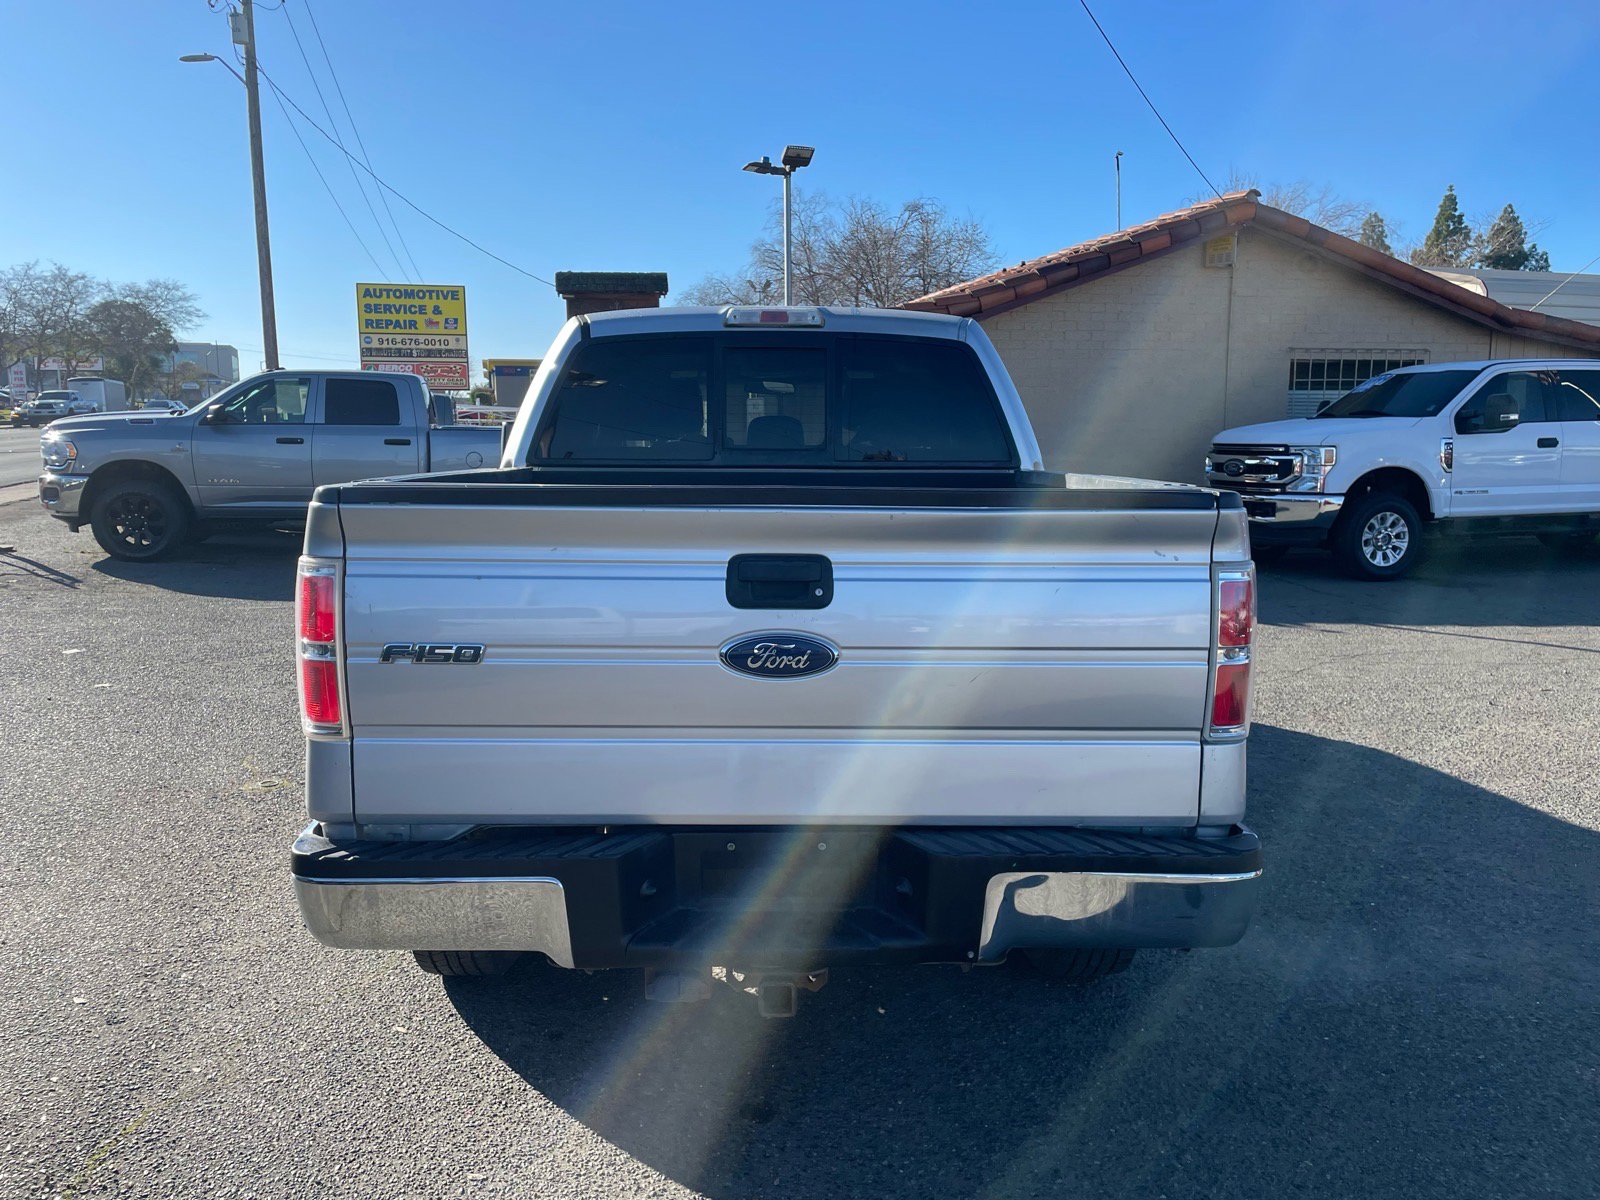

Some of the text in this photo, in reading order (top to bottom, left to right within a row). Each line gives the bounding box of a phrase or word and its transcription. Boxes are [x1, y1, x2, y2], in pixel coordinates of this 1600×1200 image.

[362, 287, 460, 300] AUTOMOTIVE
[363, 303, 443, 315] SERVICE &
[364, 318, 419, 330] REPAIR
[377, 337, 450, 347] 916-676-0010
[747, 642, 812, 669] Ford
